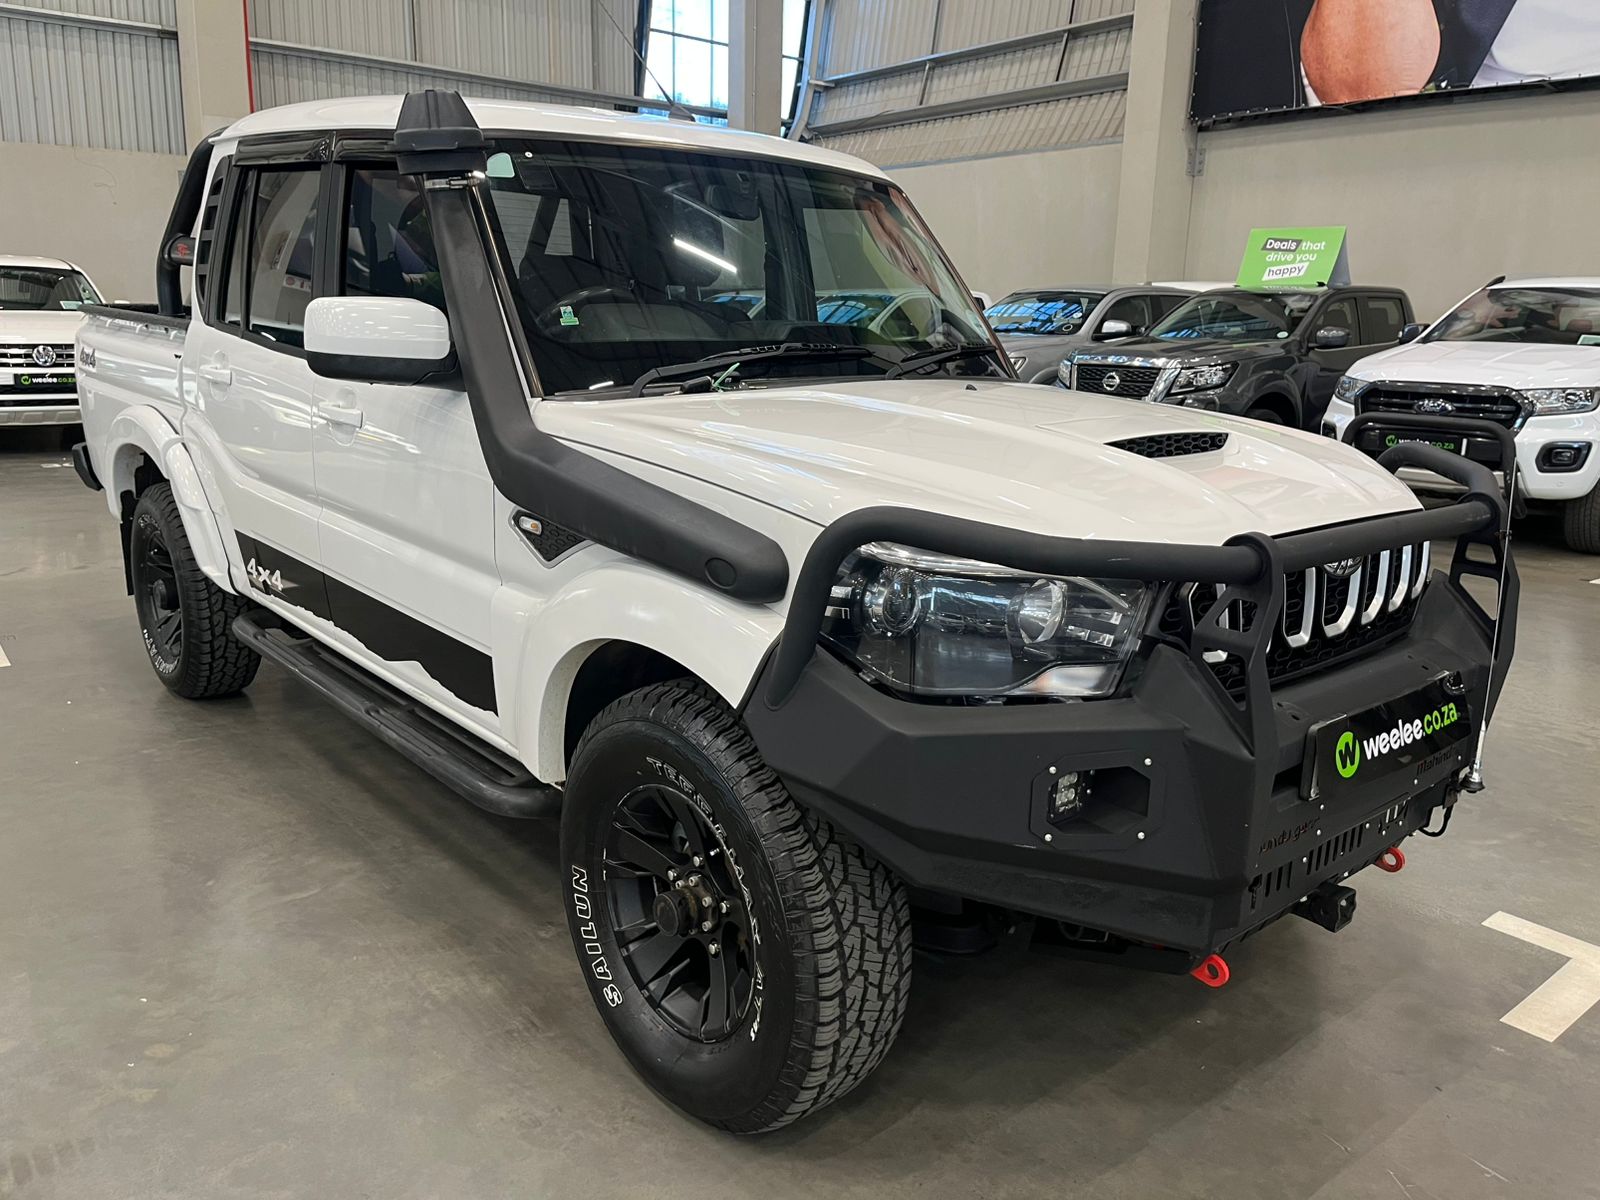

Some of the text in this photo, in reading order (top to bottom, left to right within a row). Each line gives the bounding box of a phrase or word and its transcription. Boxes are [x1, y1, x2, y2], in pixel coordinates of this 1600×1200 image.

[1266, 239, 1326, 251] Deals that
[1266, 252, 1317, 263] drive you
[1267, 264, 1304, 277] happy
[247, 558, 283, 590] 4x4
[1363, 702, 1458, 760] weelee.co.za
[572, 865, 623, 1007] SAILUN
